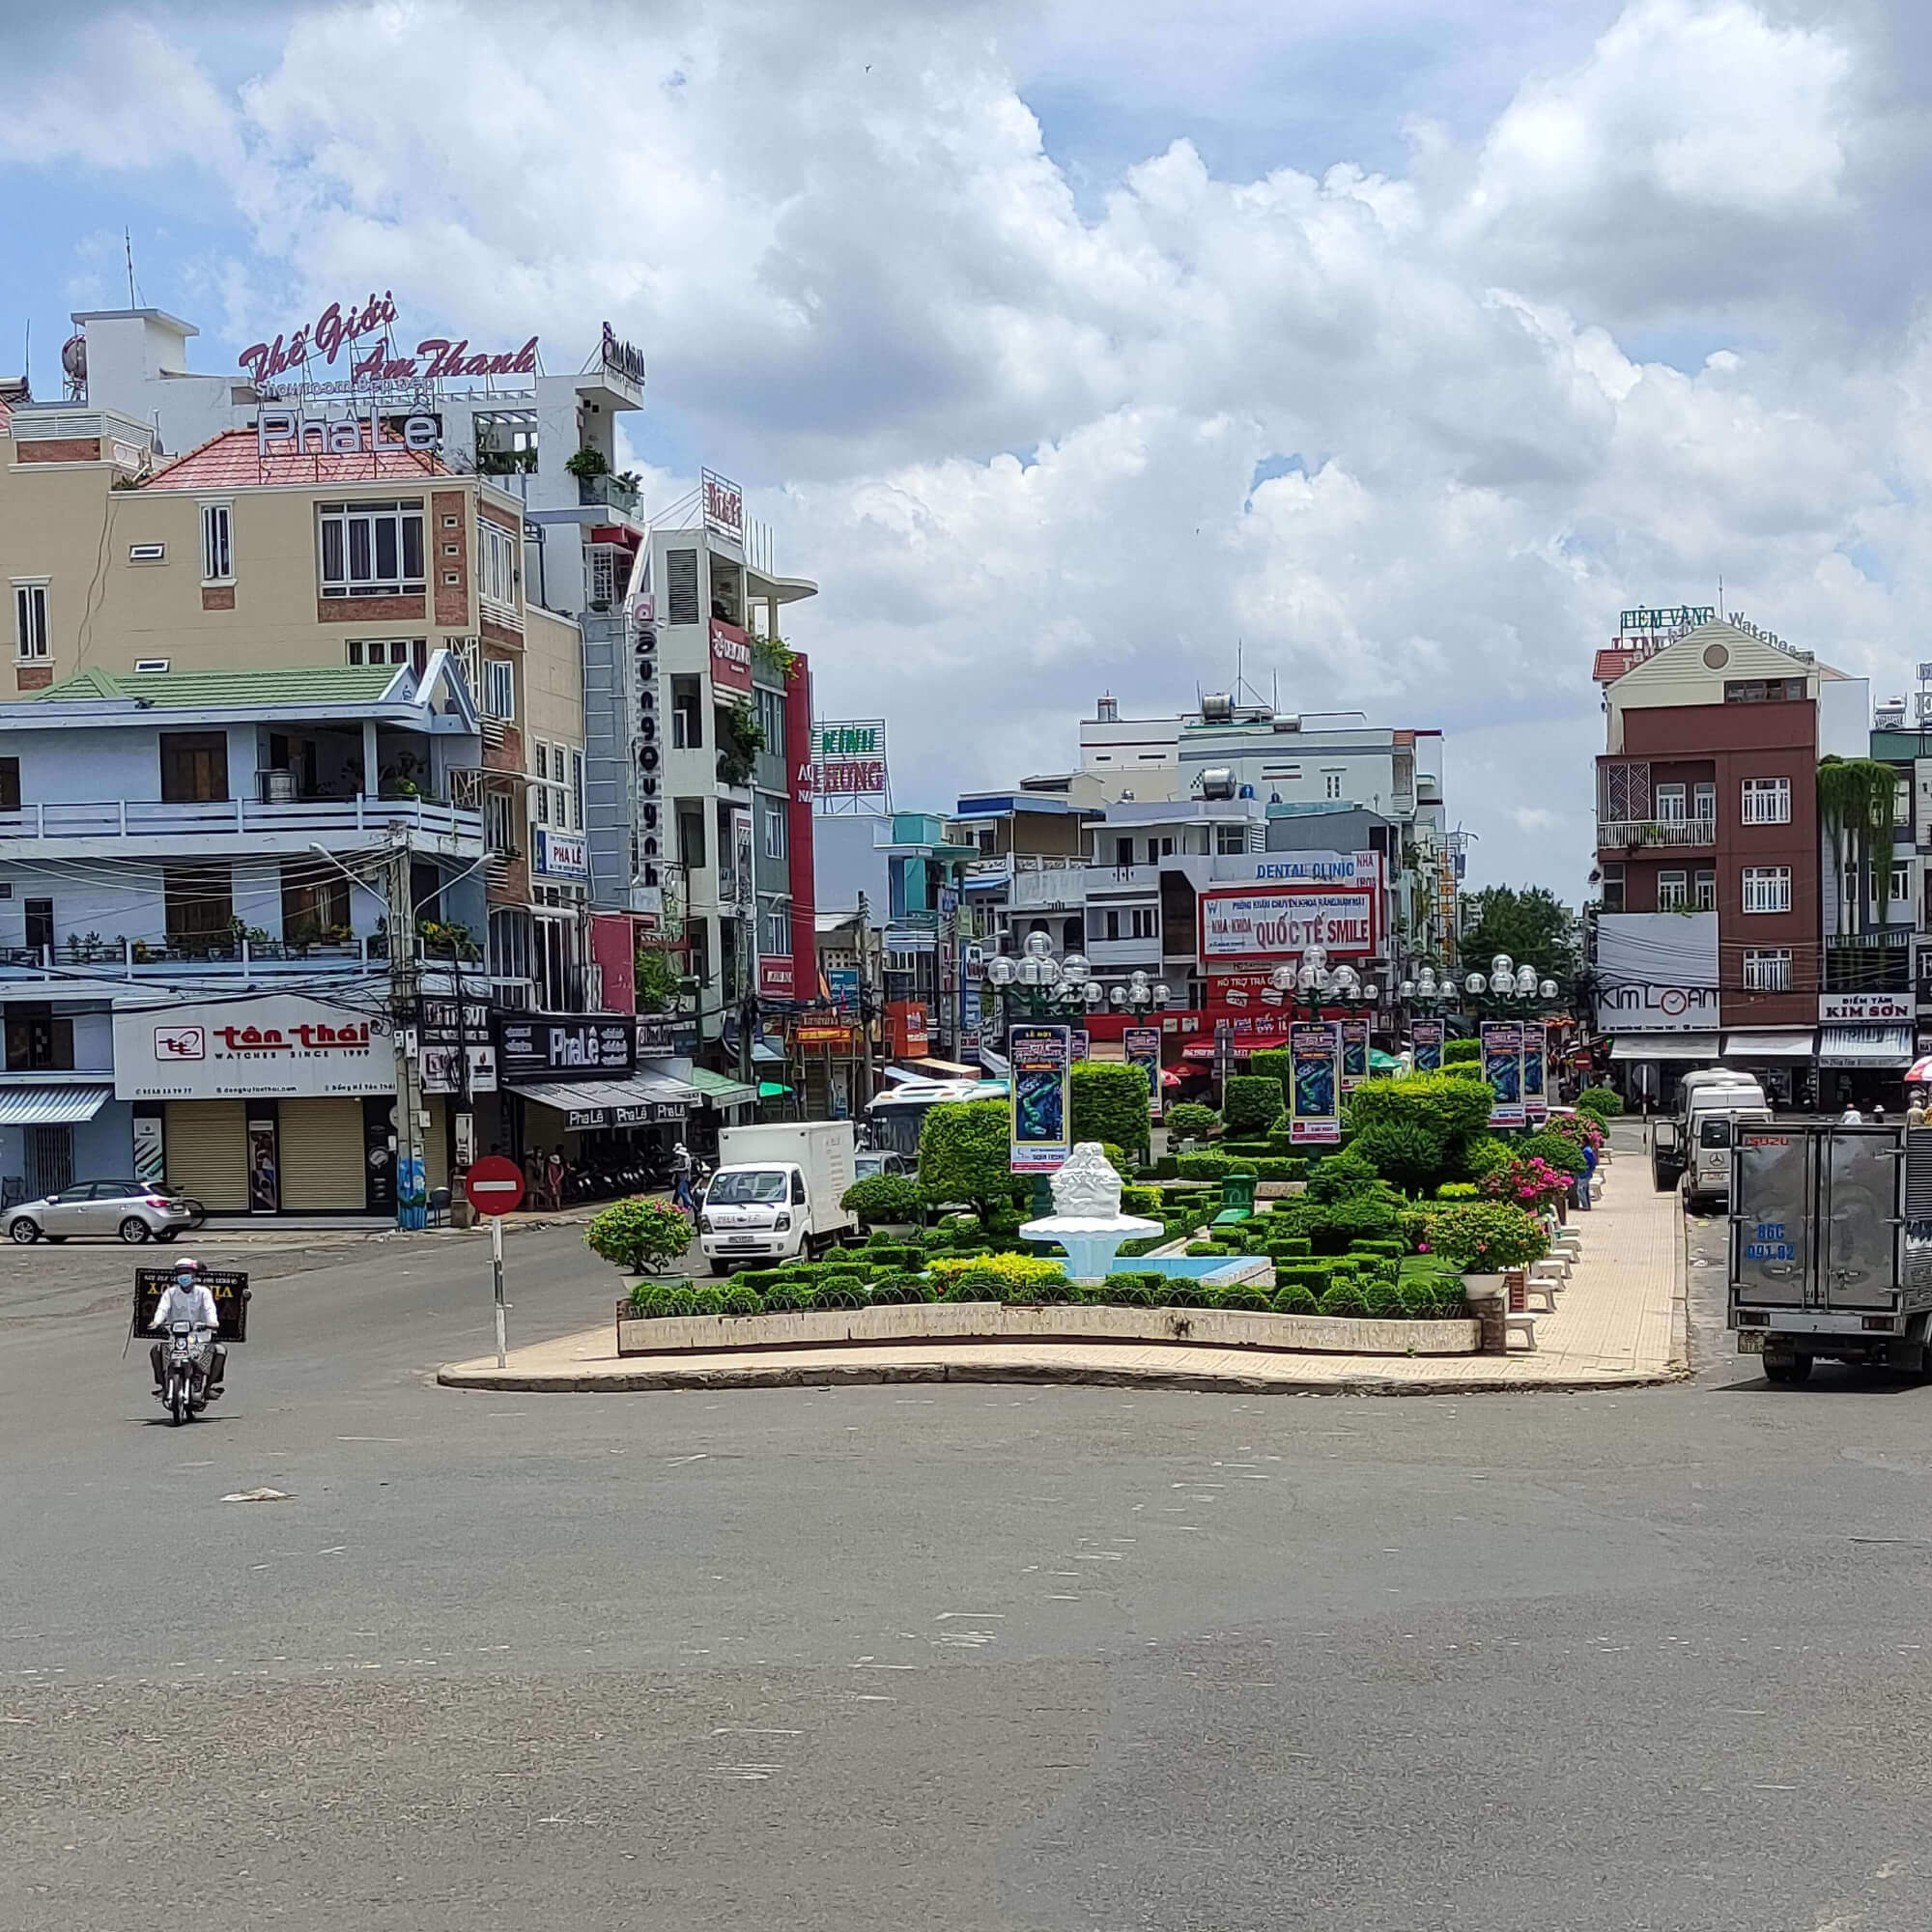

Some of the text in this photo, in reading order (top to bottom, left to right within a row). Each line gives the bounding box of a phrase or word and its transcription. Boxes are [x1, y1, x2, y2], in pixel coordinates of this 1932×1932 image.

[239, 290, 397, 383] Thế Giới
[351, 336, 539, 384] Âm Thanh
[1728, 611, 1796, 656] Watches
[554, 845, 582, 866] PHA LÊ
[1256, 864, 1307, 879] DENTAL
[1256, 911, 1300, 951] QUỐC
[1301, 911, 1325, 944] TẾ
[1327, 919, 1369, 943] SMILE
[1826, 1003, 1909, 1018] KIM SƠN
[213, 1023, 369, 1050] tân thái
[214, 1049, 370, 1061] WATCHES SINCE 1999
[1757, 1223, 1785, 1239] 86C
